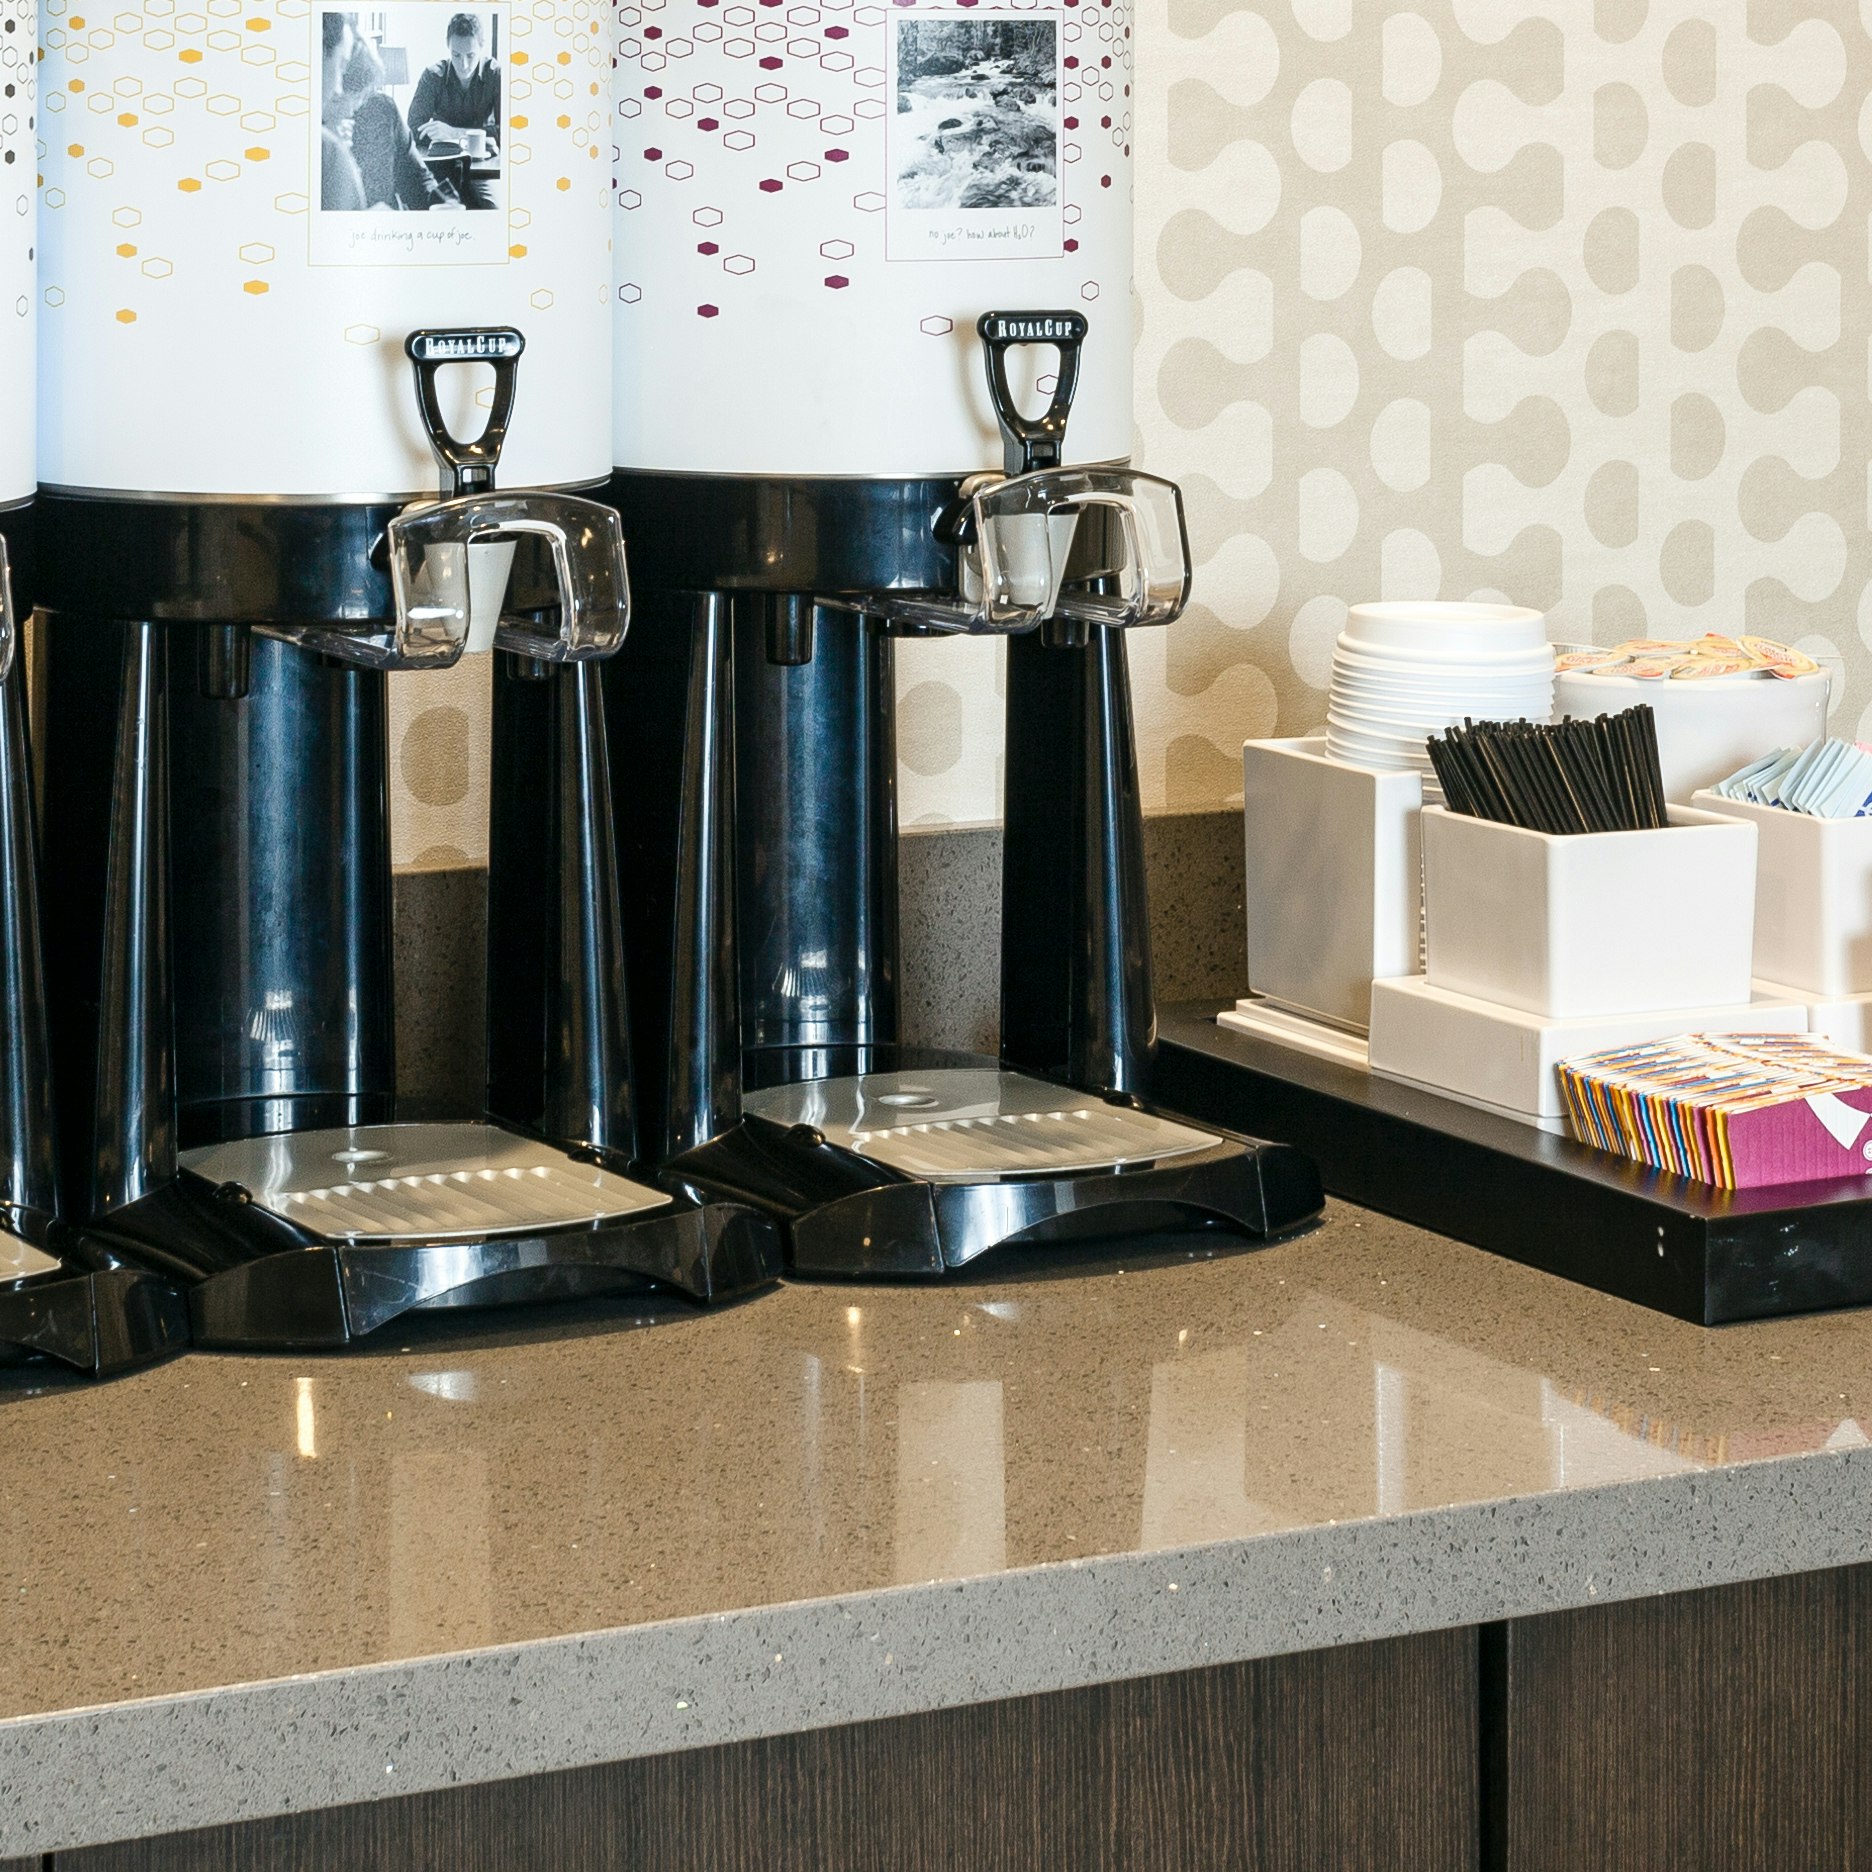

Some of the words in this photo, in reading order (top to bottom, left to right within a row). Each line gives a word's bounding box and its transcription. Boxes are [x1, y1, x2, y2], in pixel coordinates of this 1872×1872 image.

[348, 230, 366, 248] joe
[370, 228, 414, 252] drinking
[416, 231, 424, 240] a
[426, 231, 445, 244] cup
[447, 226, 456, 240] of
[928, 230, 940, 239] no
[941, 227, 963, 245] joe?
[966, 229, 985, 239] how
[987, 226, 1011, 239] about
